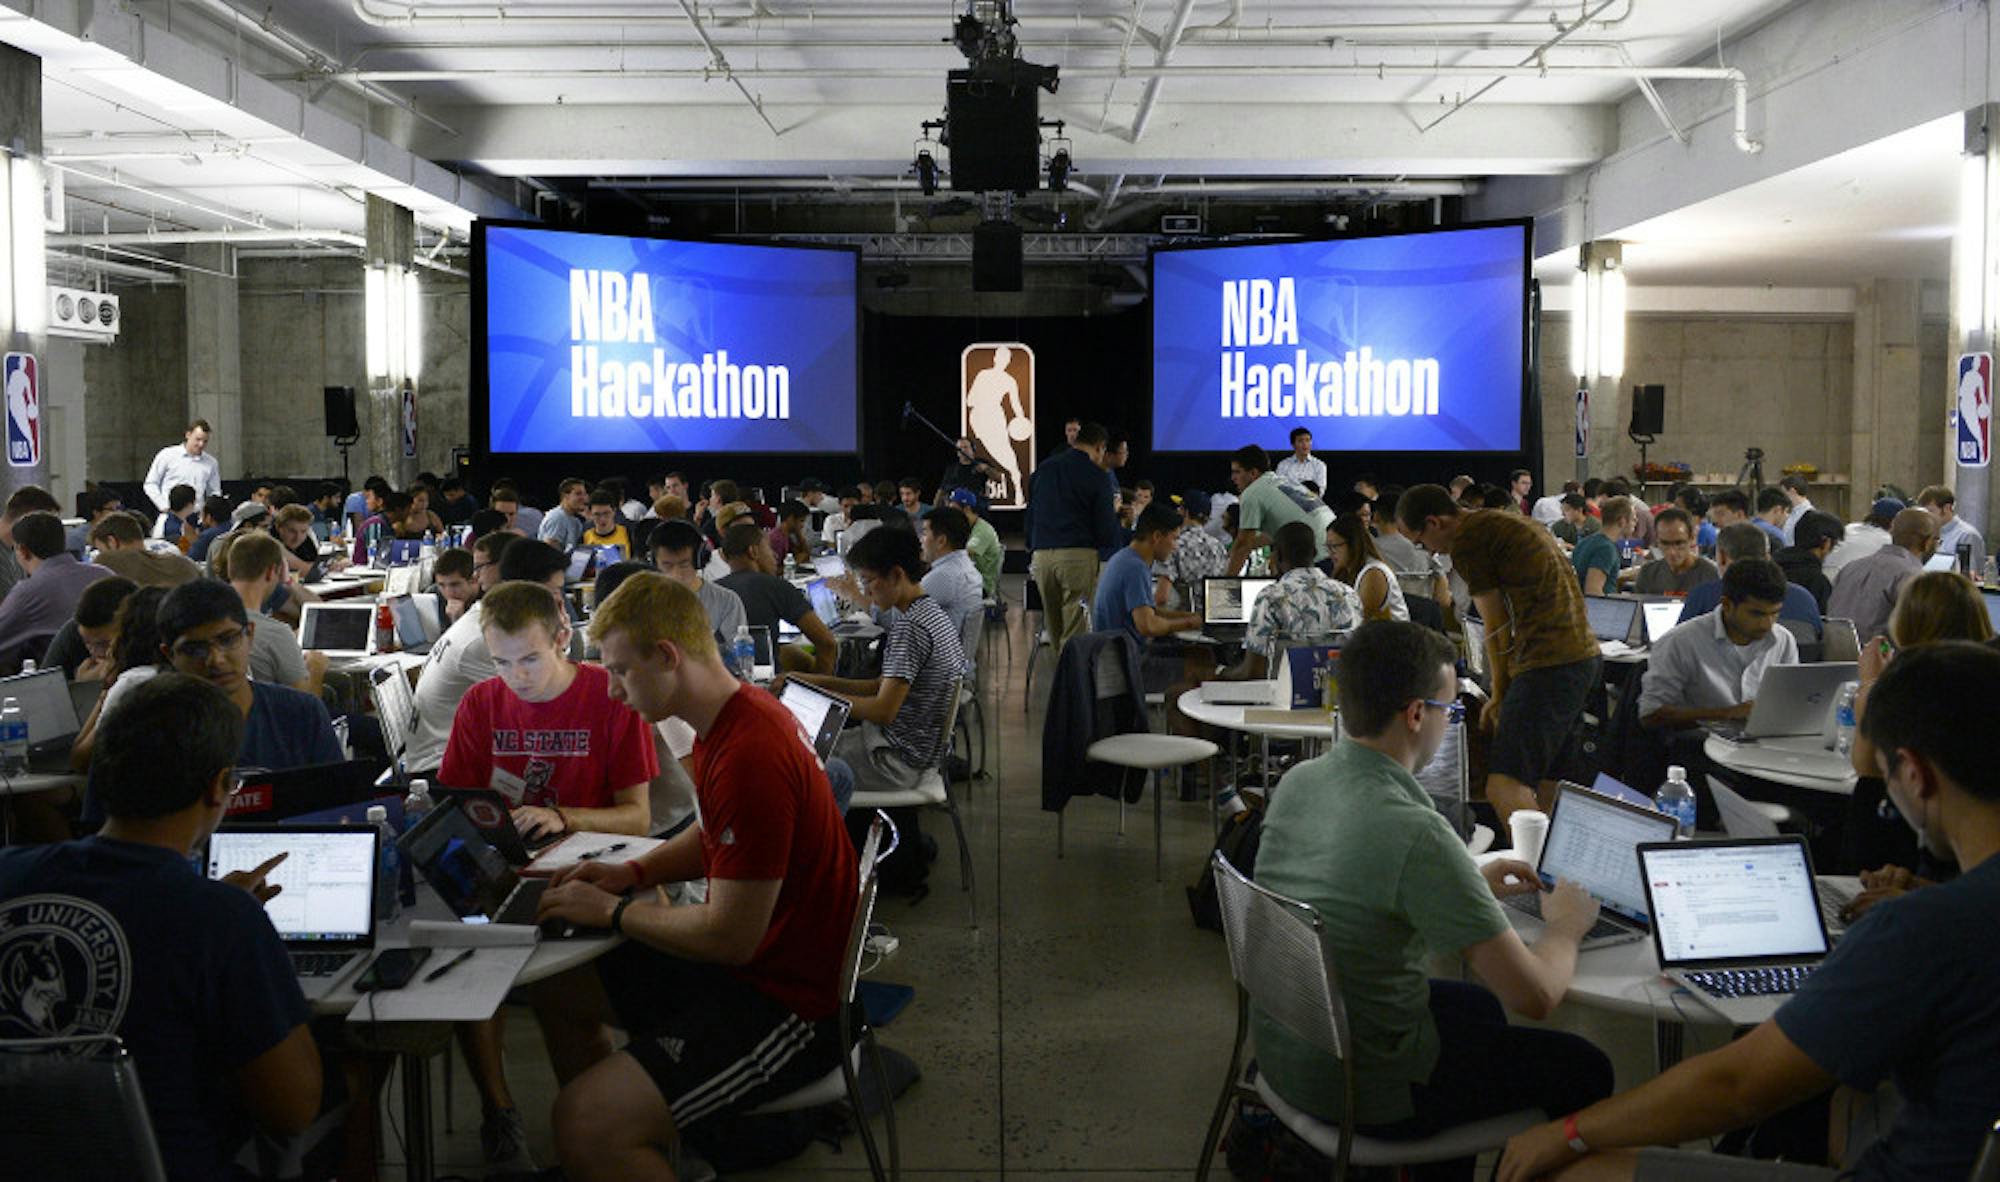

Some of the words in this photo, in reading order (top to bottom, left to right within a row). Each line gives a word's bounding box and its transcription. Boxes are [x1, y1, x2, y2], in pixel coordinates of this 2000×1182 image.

[569, 269, 655, 343] NBA
[1221, 277, 1299, 347] NBA
[571, 345, 789, 419] Hackathon
[1221, 346, 1439, 417] Hackathon
[985, 473, 1008, 499] BA
[492, 729, 519, 752] NC
[523, 729, 591, 752] STATE
[224, 791, 263, 809] TATE
[27, 904, 119, 999] UNIVERSITY
